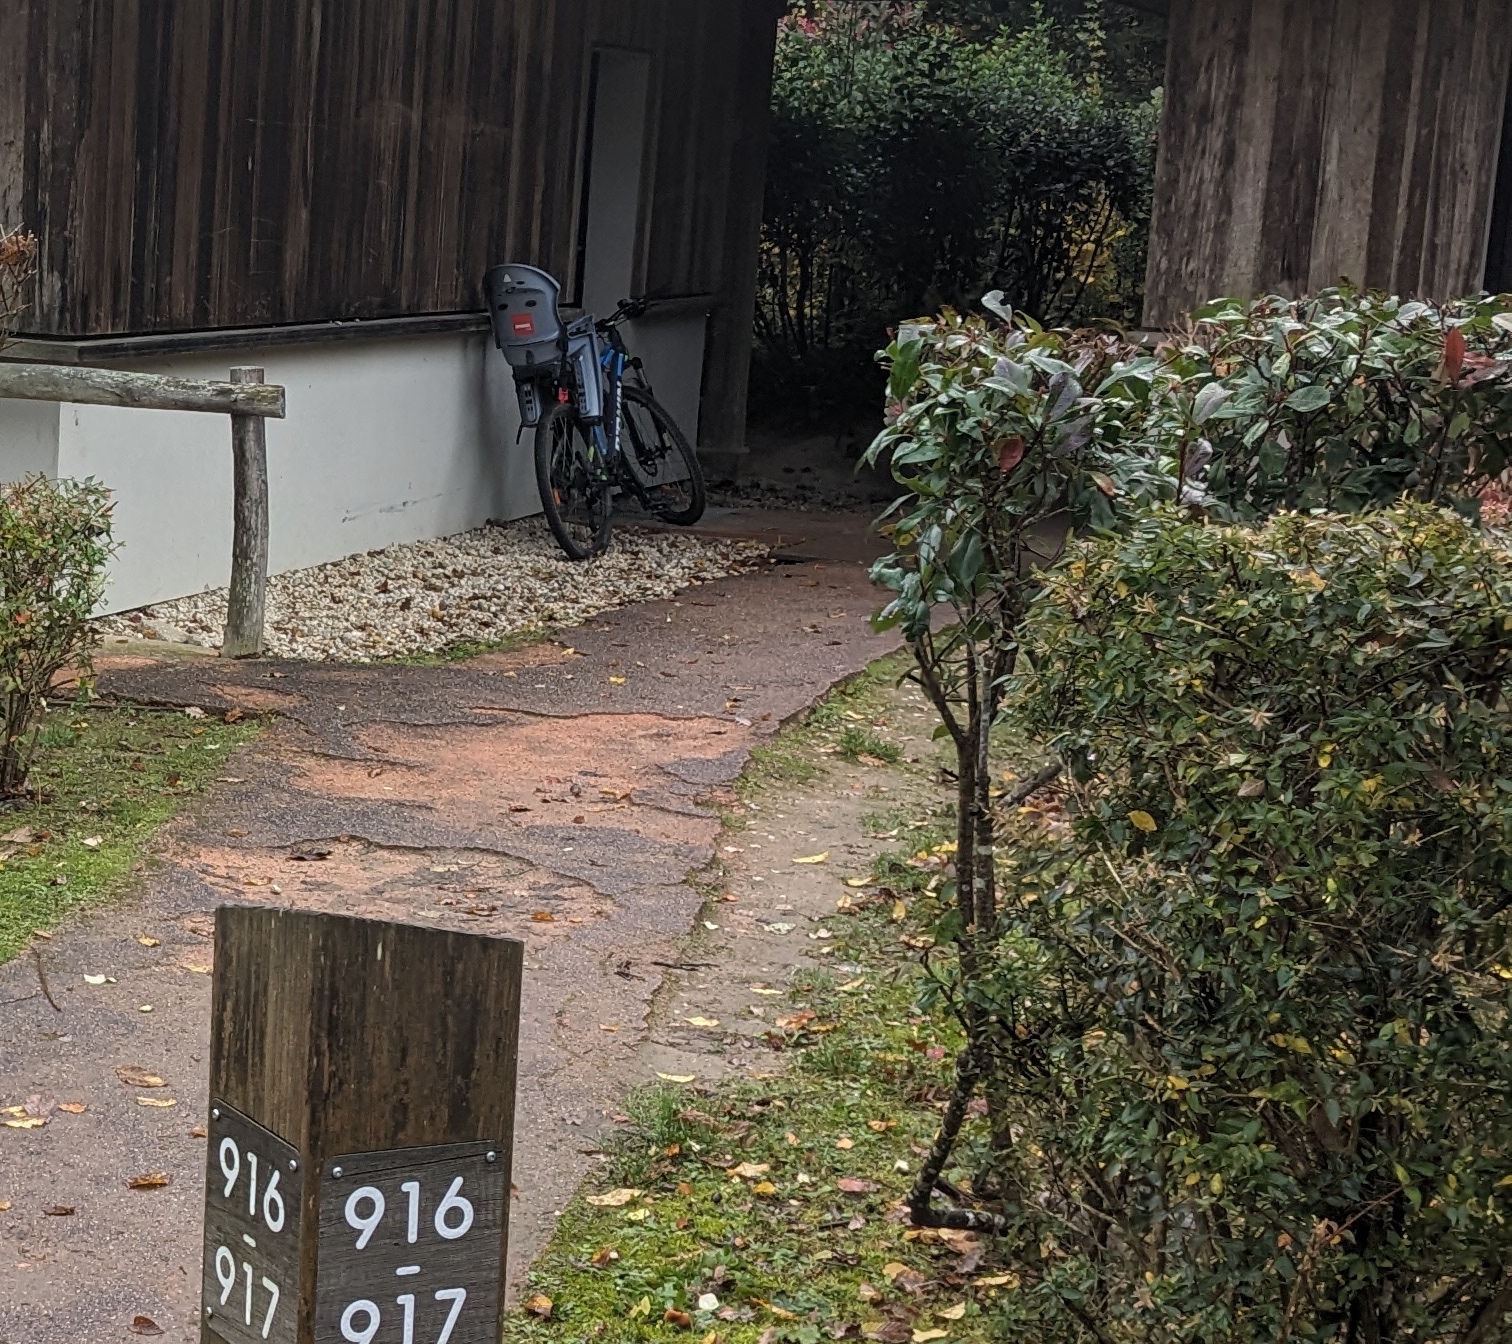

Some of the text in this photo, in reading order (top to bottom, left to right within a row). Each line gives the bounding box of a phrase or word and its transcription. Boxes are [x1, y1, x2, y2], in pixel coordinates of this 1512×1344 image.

[219, 1137, 285, 1233] 916
[344, 1176, 475, 1250] 916
[215, 1245, 280, 1339] 917
